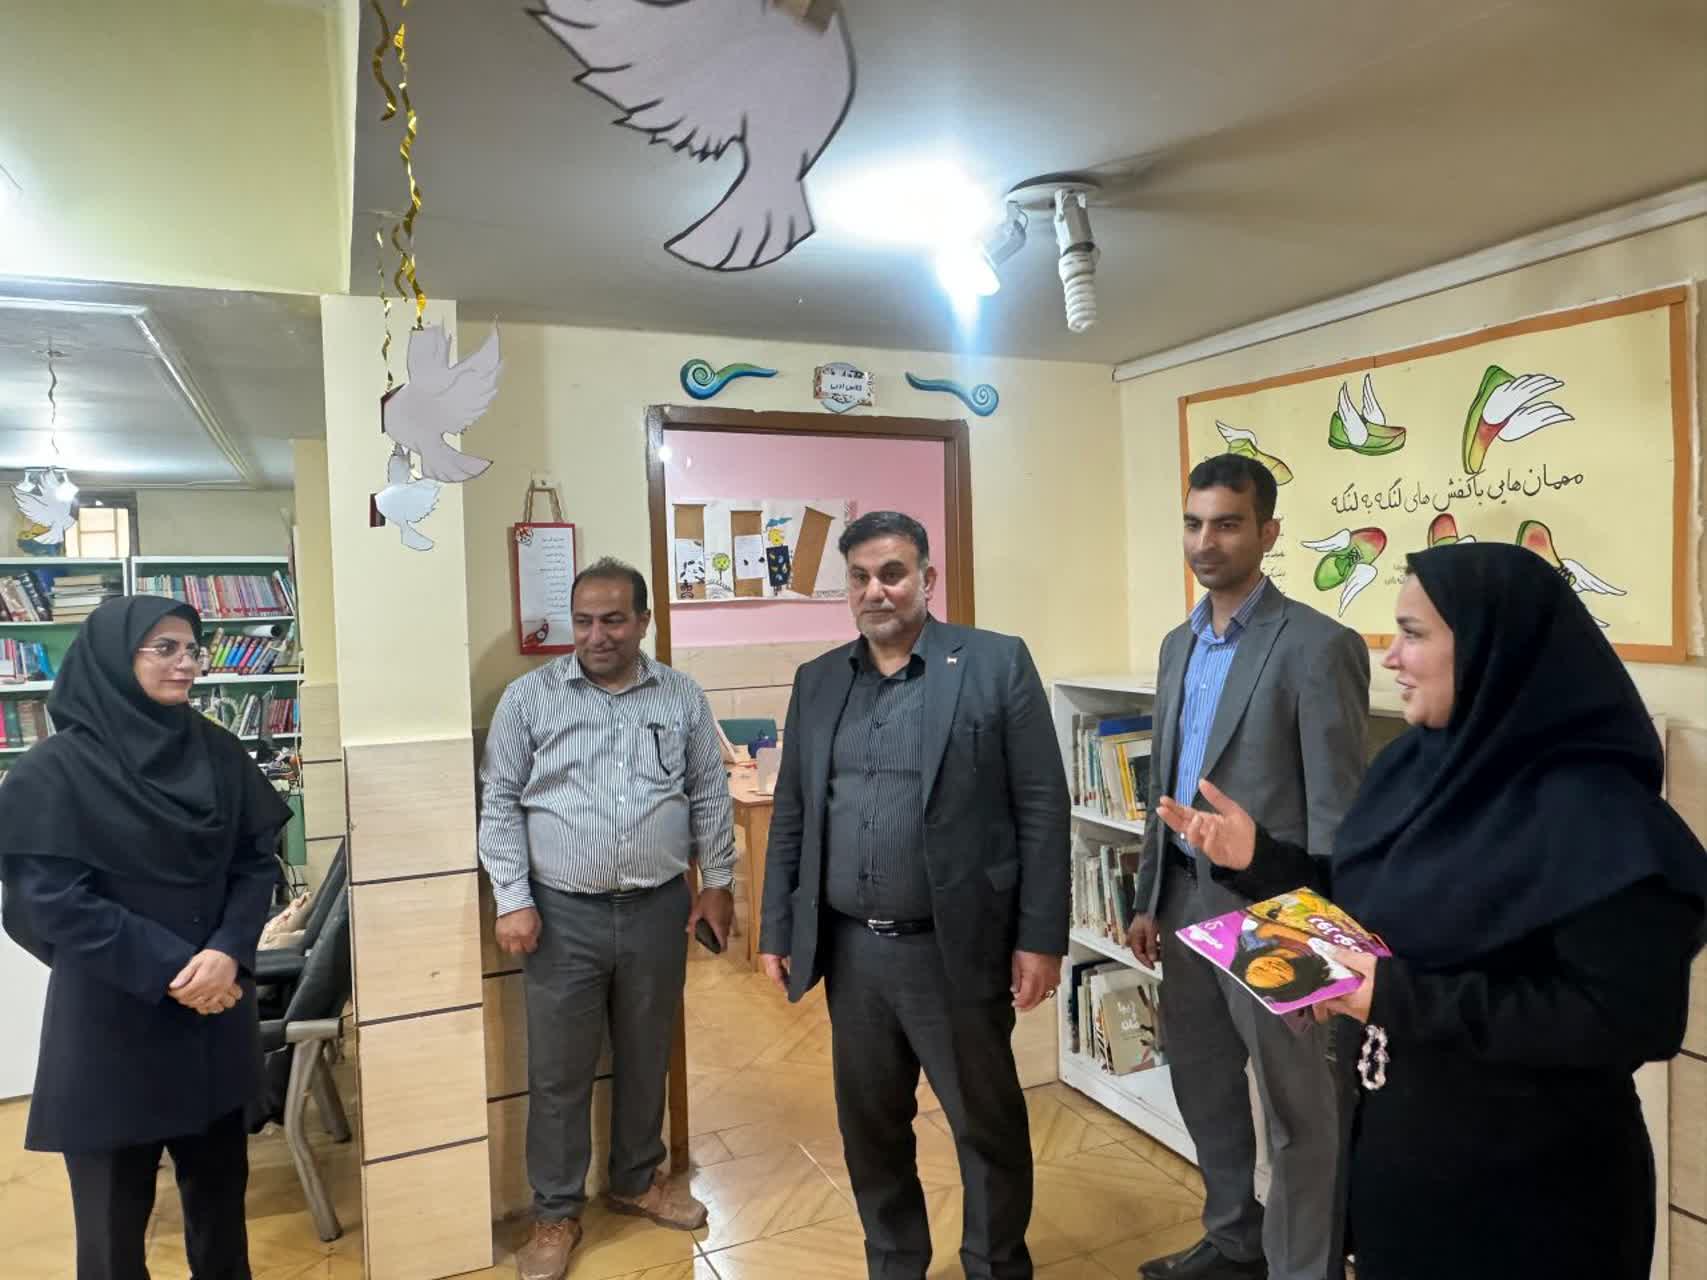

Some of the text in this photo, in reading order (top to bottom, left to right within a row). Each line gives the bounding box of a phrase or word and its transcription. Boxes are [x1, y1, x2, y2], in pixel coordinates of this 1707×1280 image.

[1331, 482, 1358, 513] لنگه
[1361, 494, 1373, 514] به
[1375, 478, 1402, 509] لنگه
[1405, 481, 1430, 512] های
